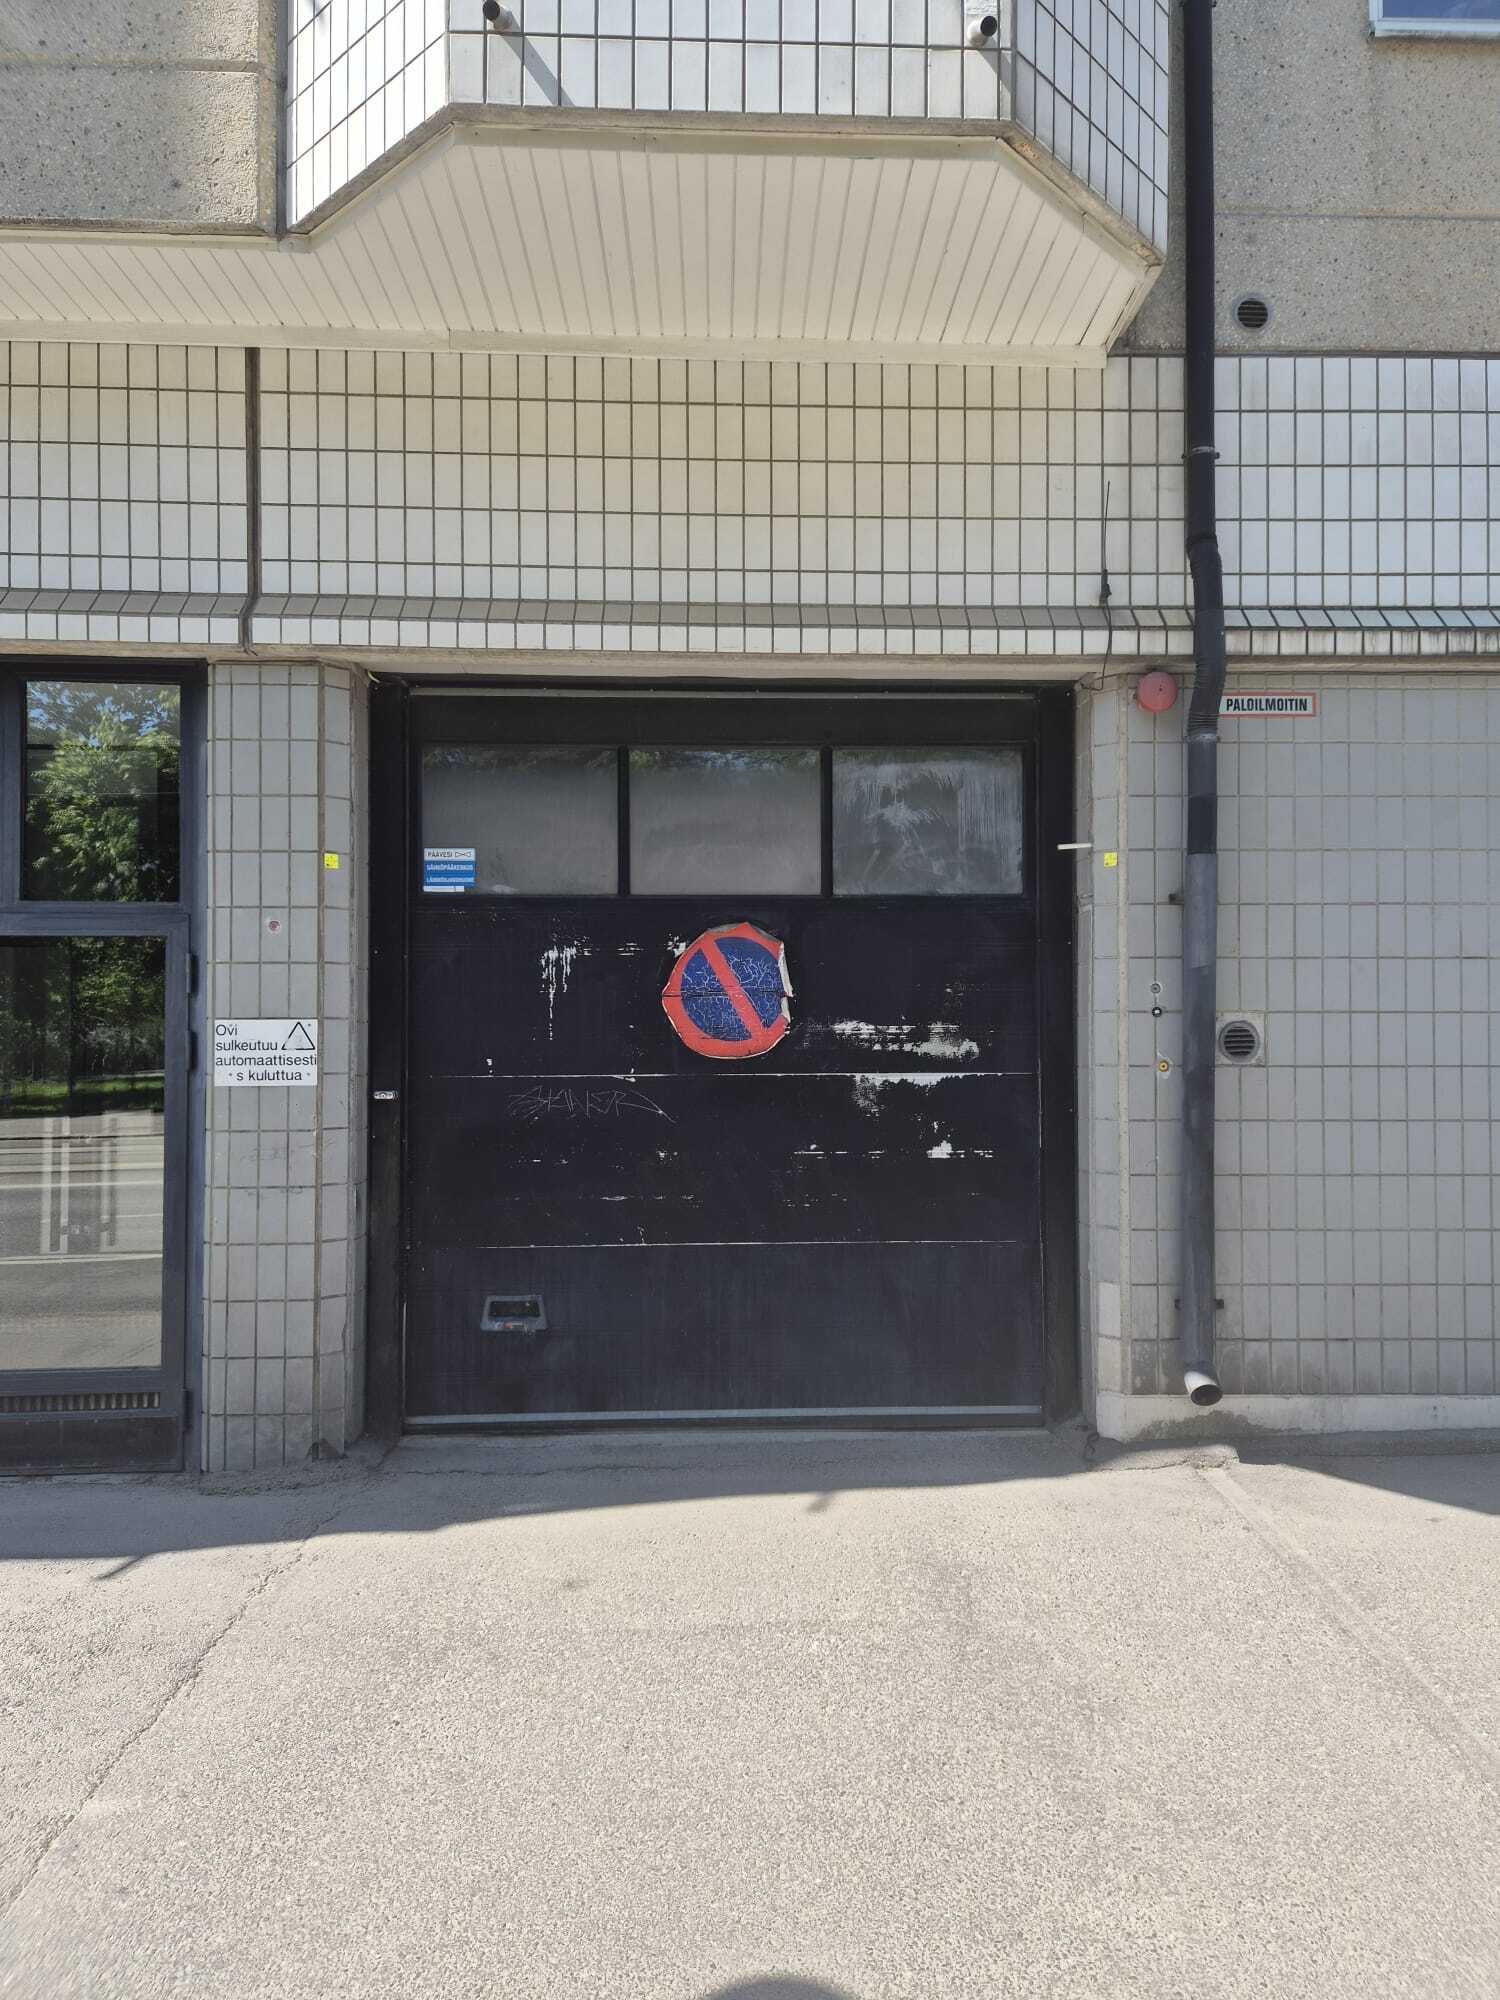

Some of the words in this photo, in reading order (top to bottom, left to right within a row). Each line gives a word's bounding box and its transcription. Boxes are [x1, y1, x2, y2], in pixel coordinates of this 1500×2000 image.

[1226, 698, 1307, 712] PALOILMOITIN
[215, 1023, 238, 1036] Ovi
[215, 1039, 278, 1051] sulkeutuu
[215, 1053, 317, 1066] automaattisesti
[236, 1072, 244, 1081] s
[248, 1069, 302, 1081] kuluttua
